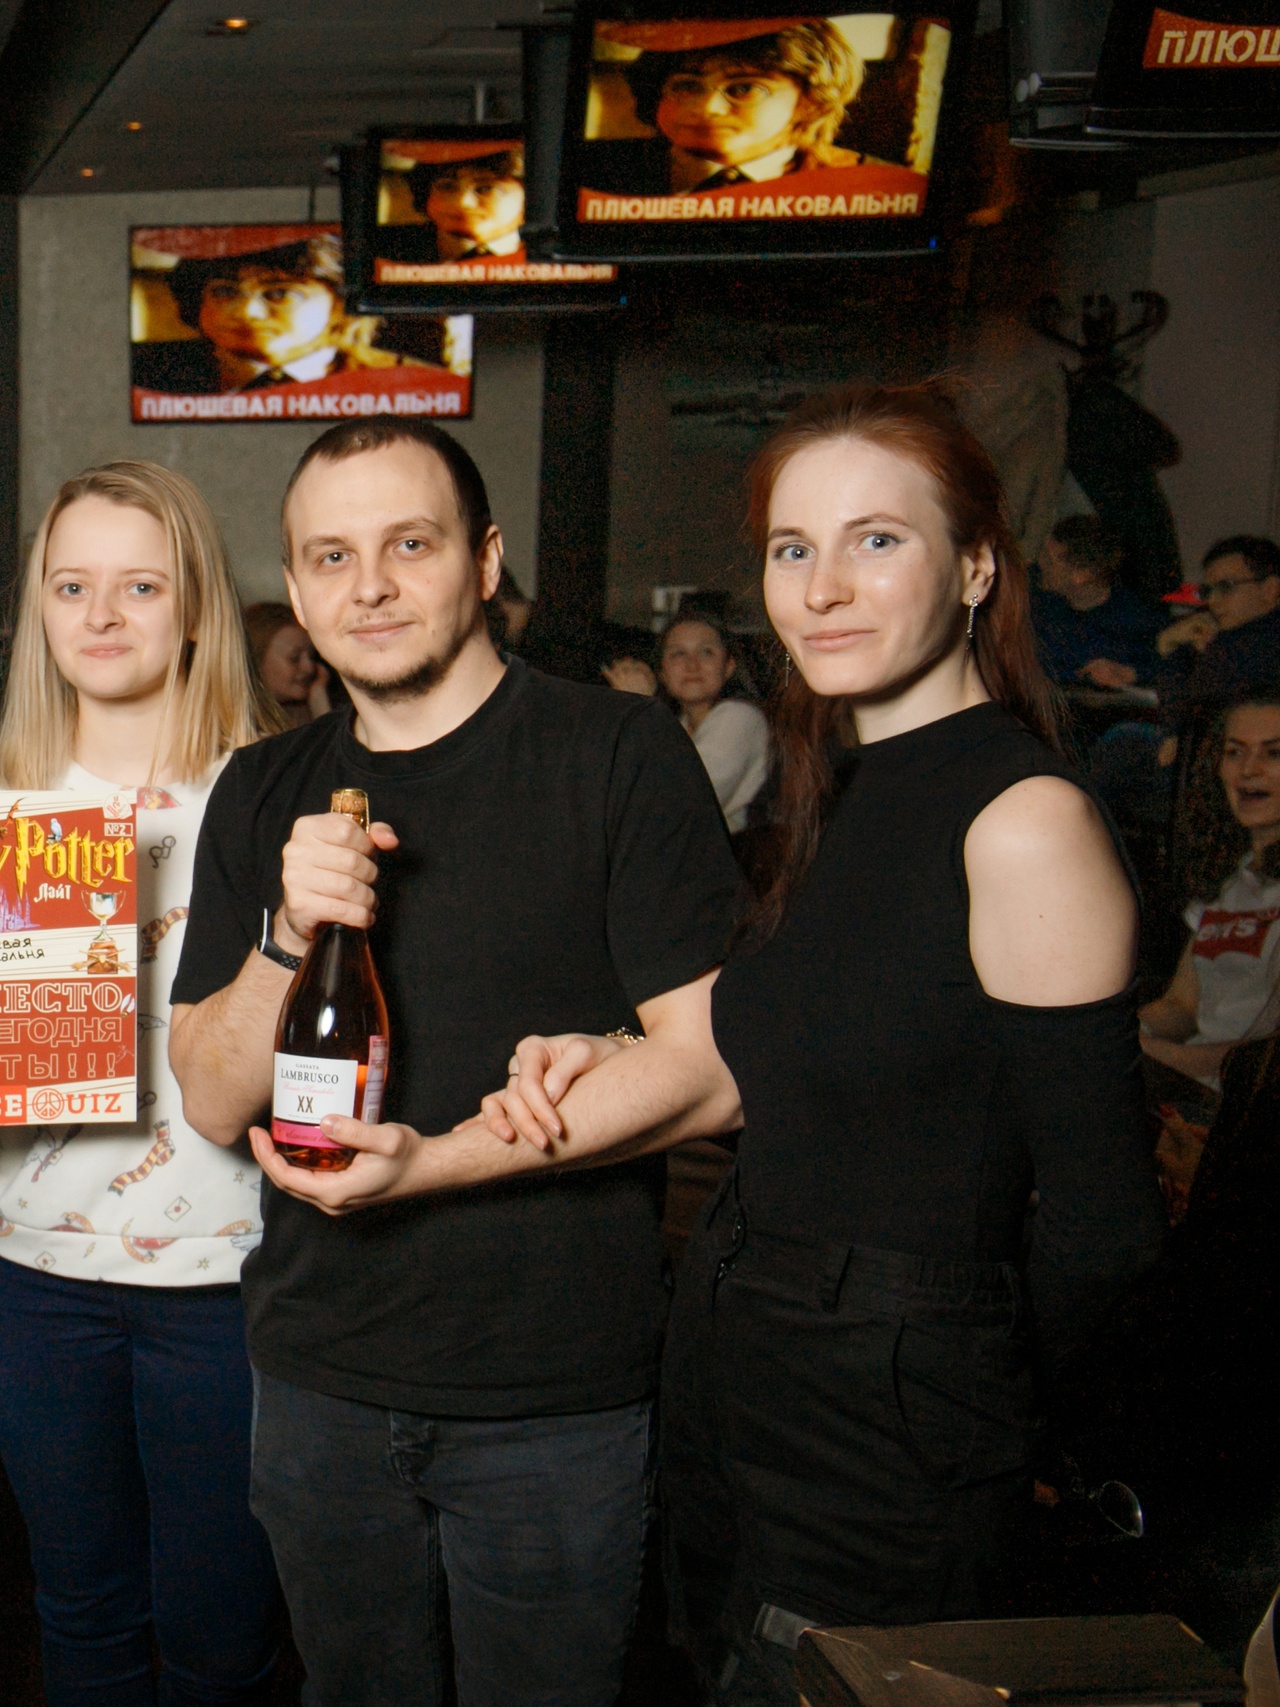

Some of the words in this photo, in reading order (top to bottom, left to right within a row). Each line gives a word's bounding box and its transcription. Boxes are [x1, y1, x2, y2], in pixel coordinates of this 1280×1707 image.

[586, 196, 735, 220] ПЛЮШЕВАЯ
[740, 193, 918, 217] НАКОВАЛЬНЯ
[141, 394, 284, 418] ПЛЮШЕВАЯ
[288, 392, 461, 416] НАКОВАЛЬНЯ
[15, 817, 135, 899] Potter
[34, 882, 71, 903] Лайт
[280, 1068, 339, 1085] LAMBRUSCO
[297, 1095, 314, 1113] XX
